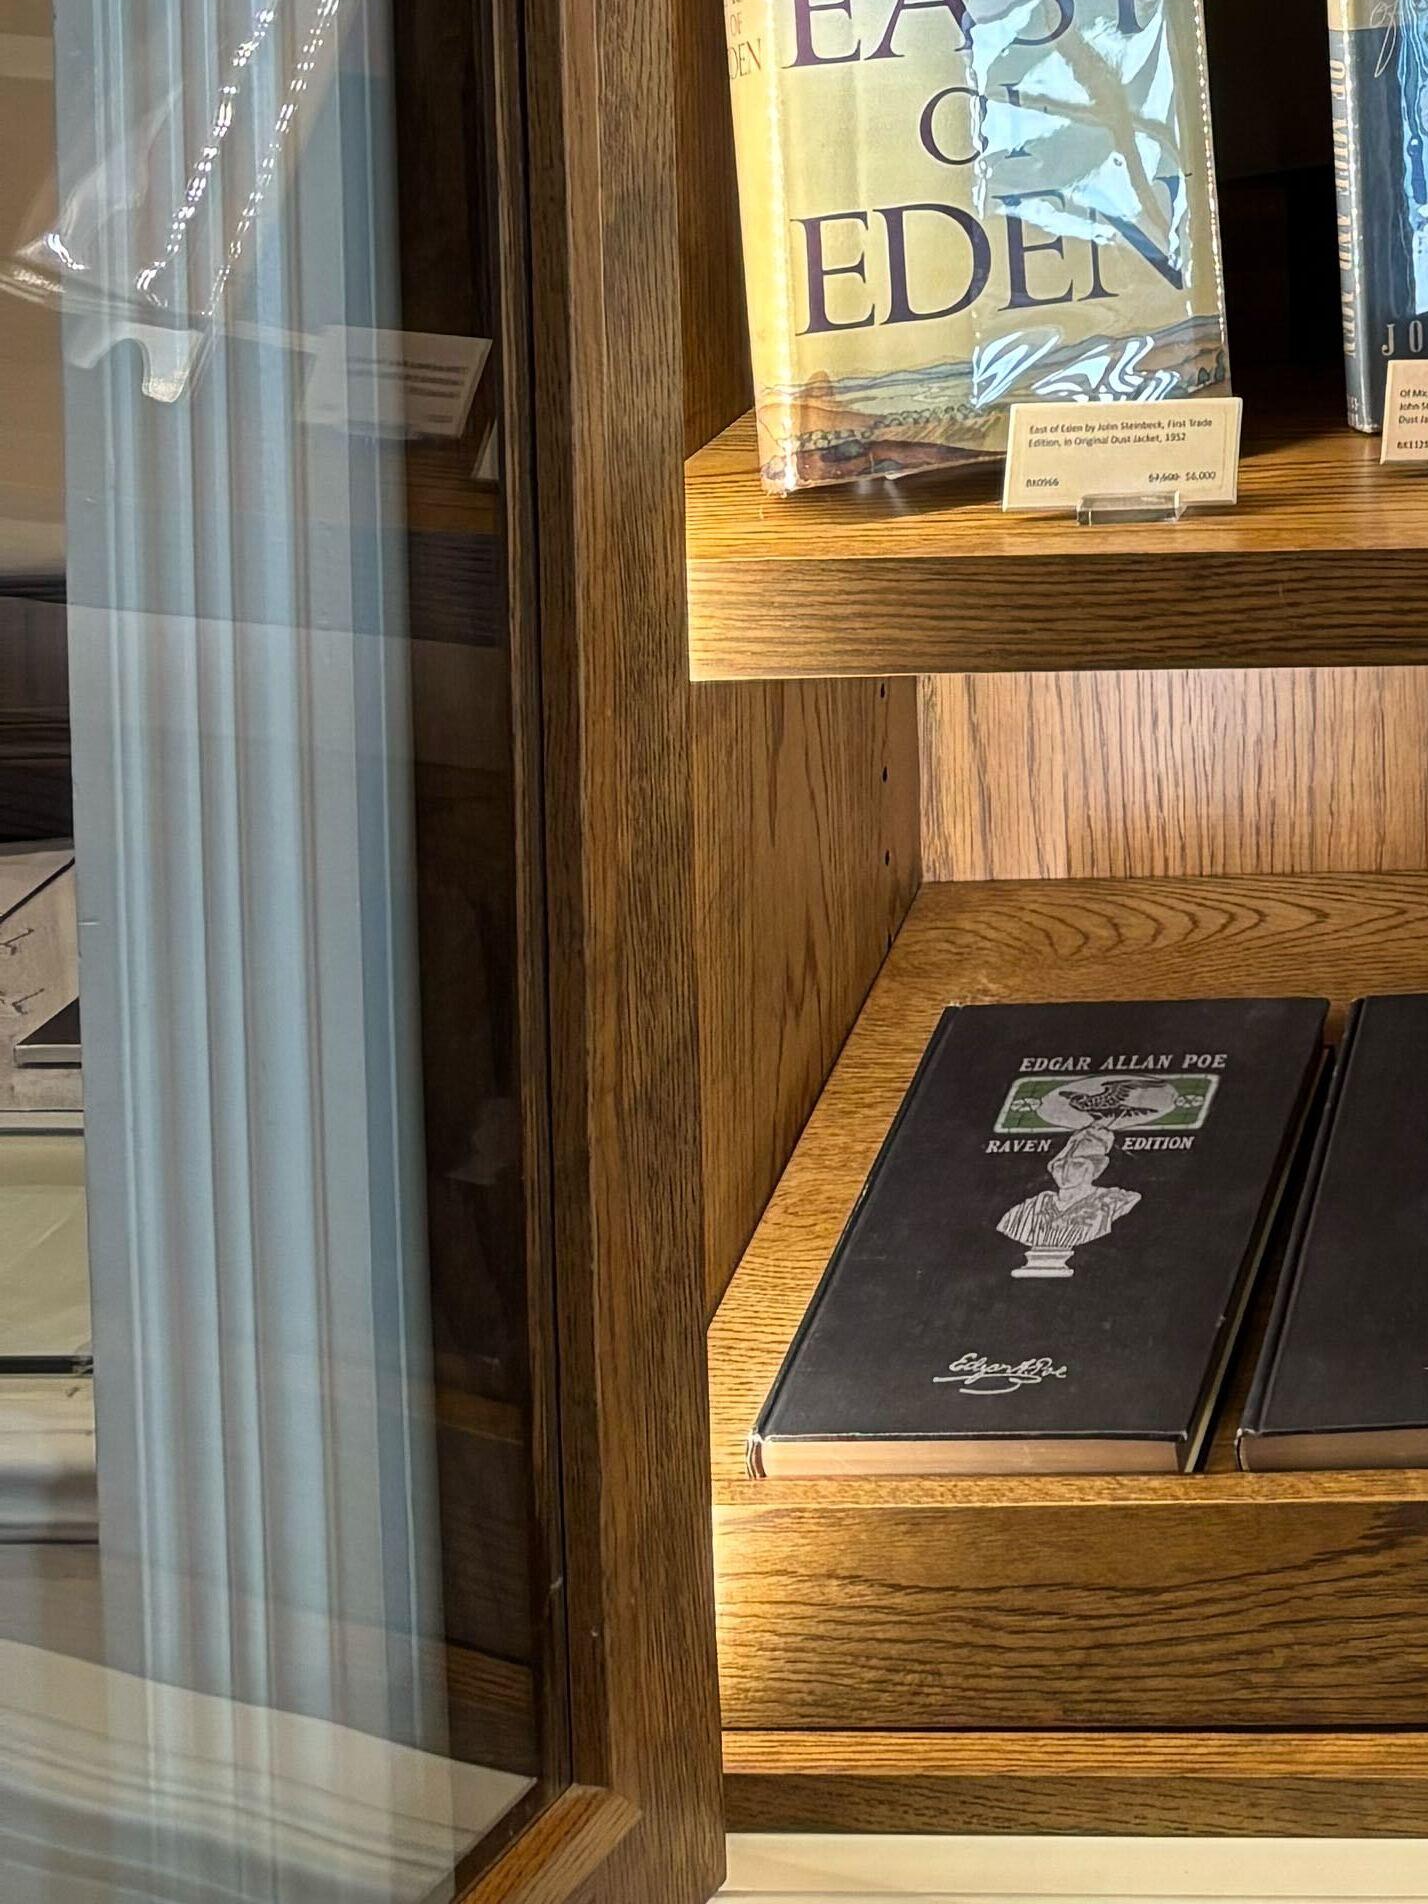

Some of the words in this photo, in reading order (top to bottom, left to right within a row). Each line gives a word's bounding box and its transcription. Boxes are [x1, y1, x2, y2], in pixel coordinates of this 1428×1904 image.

[790, 173, 1192, 337] EDEN
[1019, 1057, 1091, 1072] EDGAR
[1100, 1054, 1173, 1070] ALLAN
[1182, 1054, 1227, 1069] POE
[986, 1140, 1051, 1153] RAVEN
[1122, 1136, 1194, 1151] EDITION
